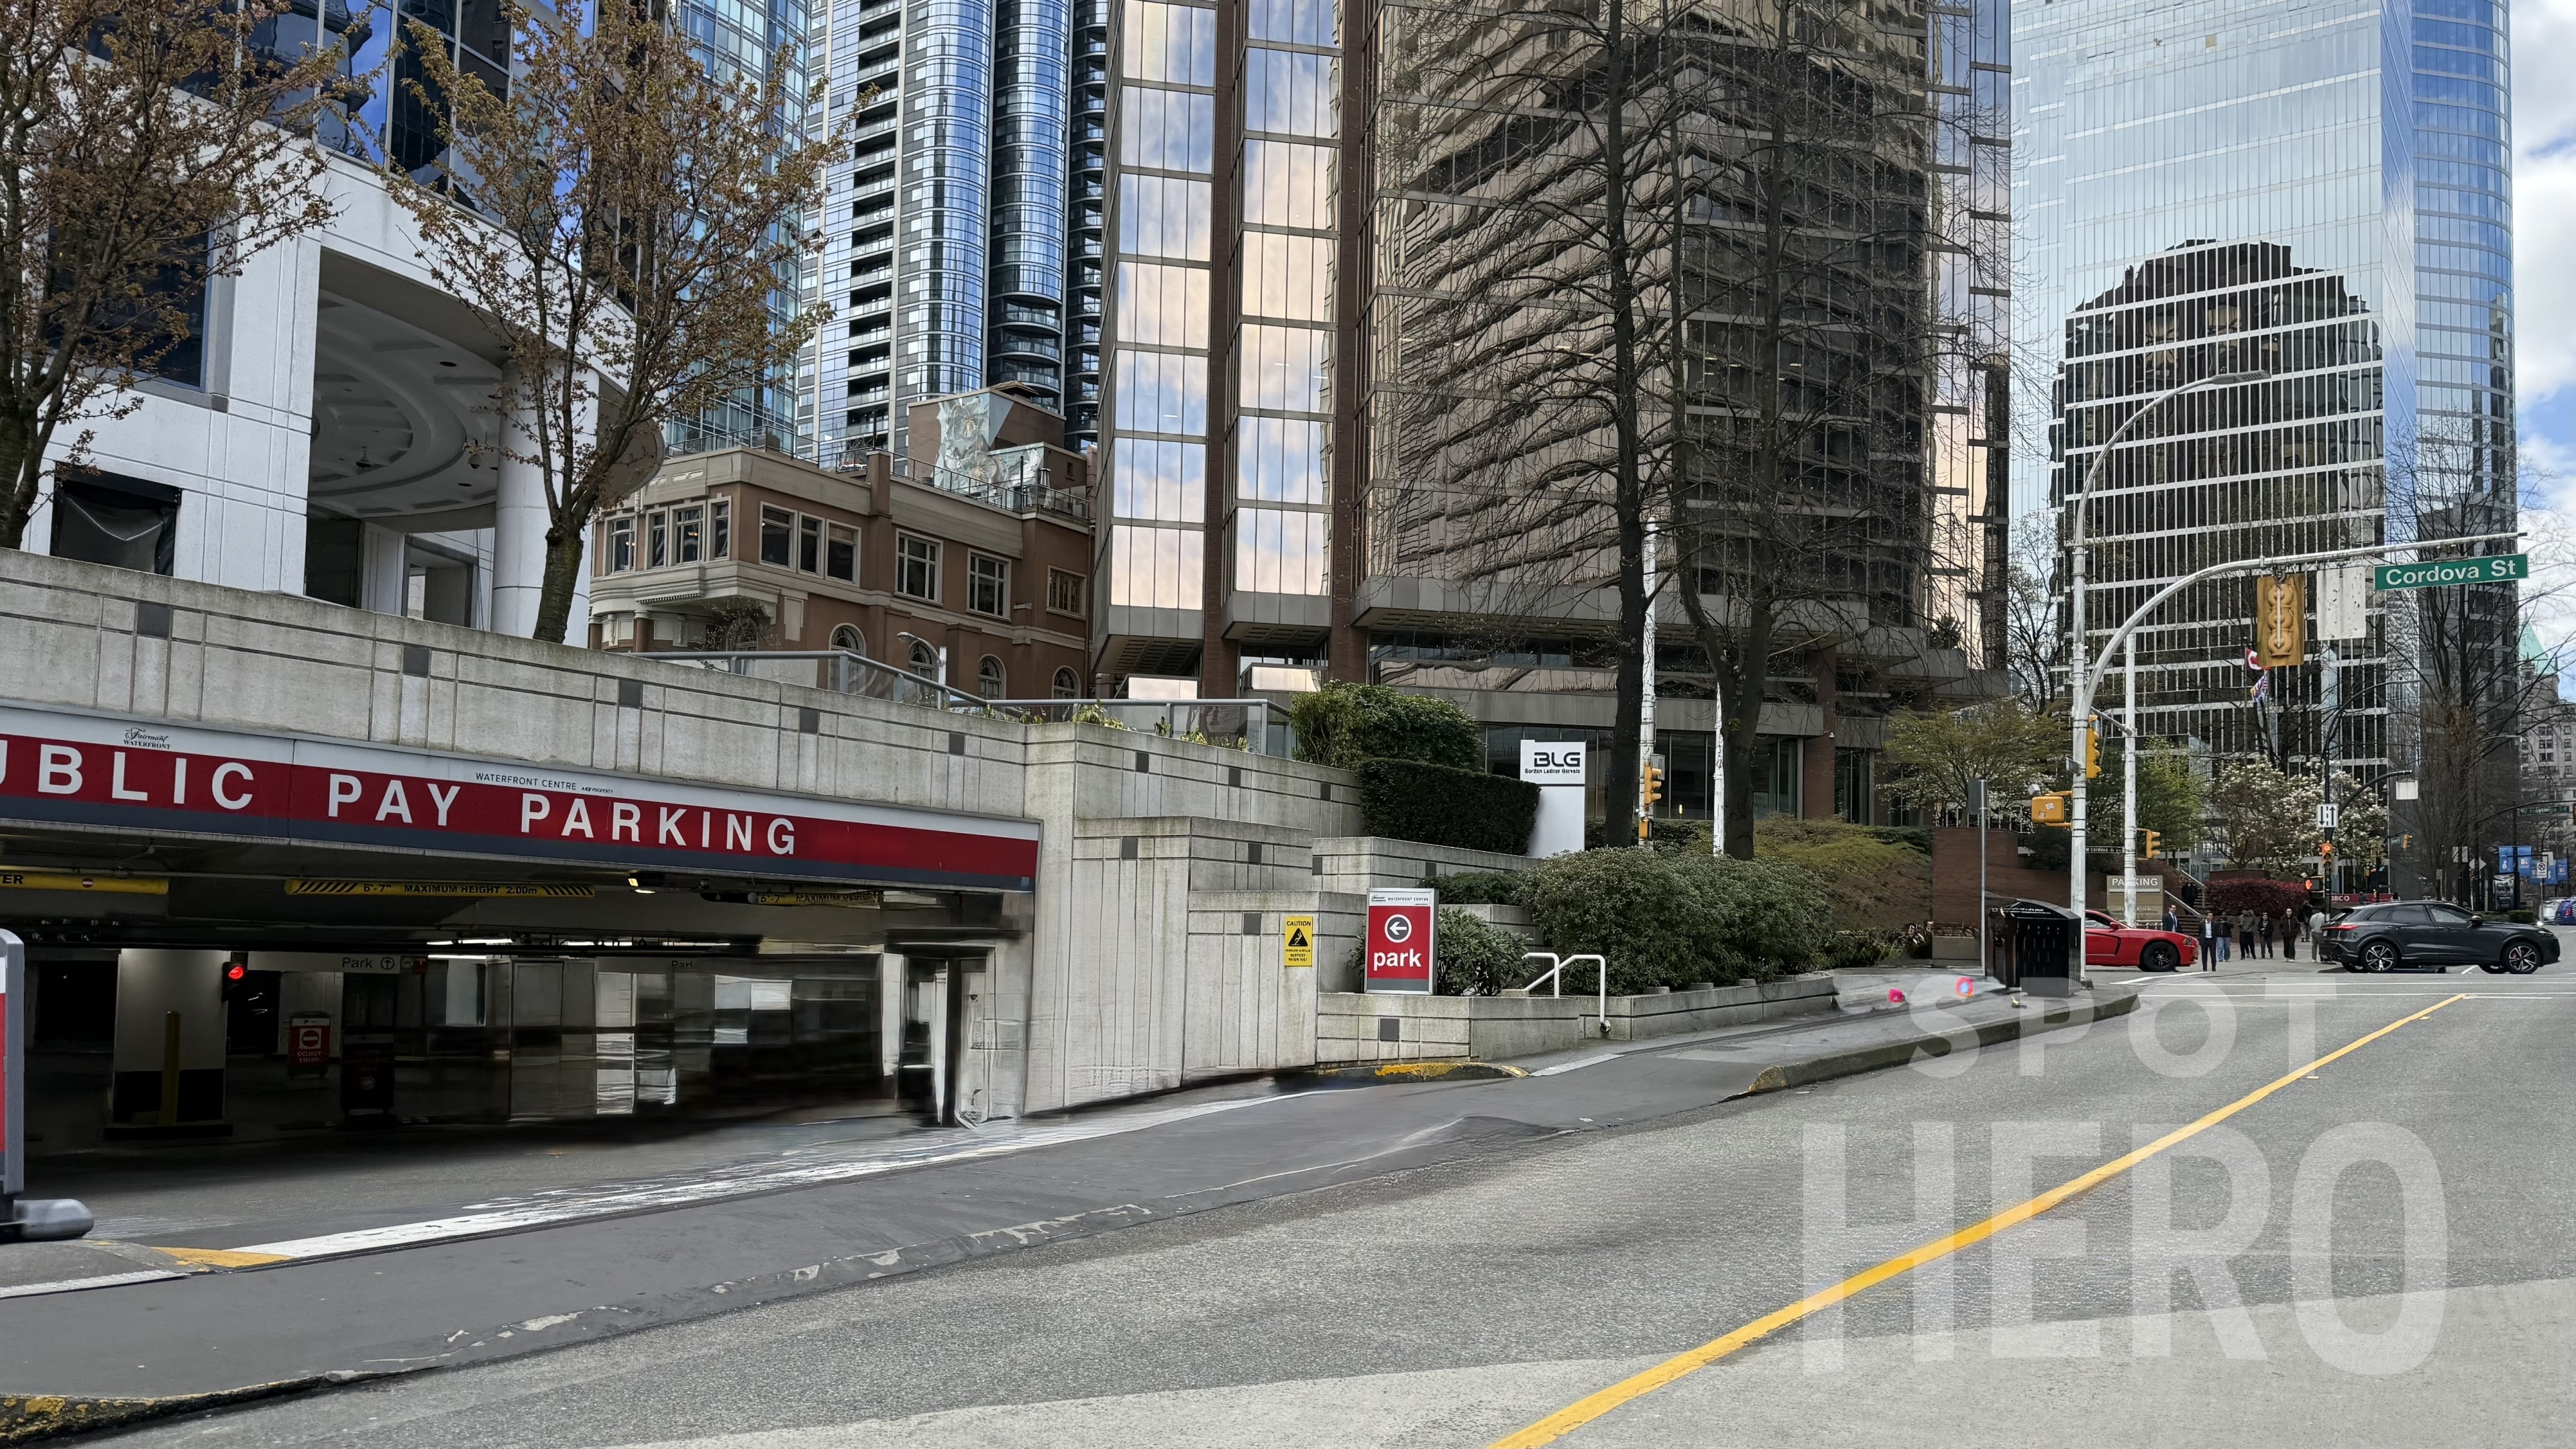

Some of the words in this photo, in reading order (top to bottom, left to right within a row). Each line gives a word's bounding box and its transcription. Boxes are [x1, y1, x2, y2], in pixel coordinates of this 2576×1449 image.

[2385, 566, 2479, 586] Cordova
[2491, 559, 2516, 577] St
[123, 739, 171, 749] WATERFRONT
[1534, 752, 1580, 767] BLG
[476, 772, 539, 786] WATERFRONT
[541, 780, 577, 790] CENTRE
[0, 740, 254, 810] BLIC
[328, 773, 461, 826] PAY
[521, 793, 796, 855] PARKING
[0, 874, 23, 884] ER
[404, 884, 458, 893] MAXIMUM
[461, 885, 500, 894] HEIGHT
[506, 886, 537, 894] 2.00m
[342, 957, 373, 968] Park
[1373, 948, 1422, 971] park
